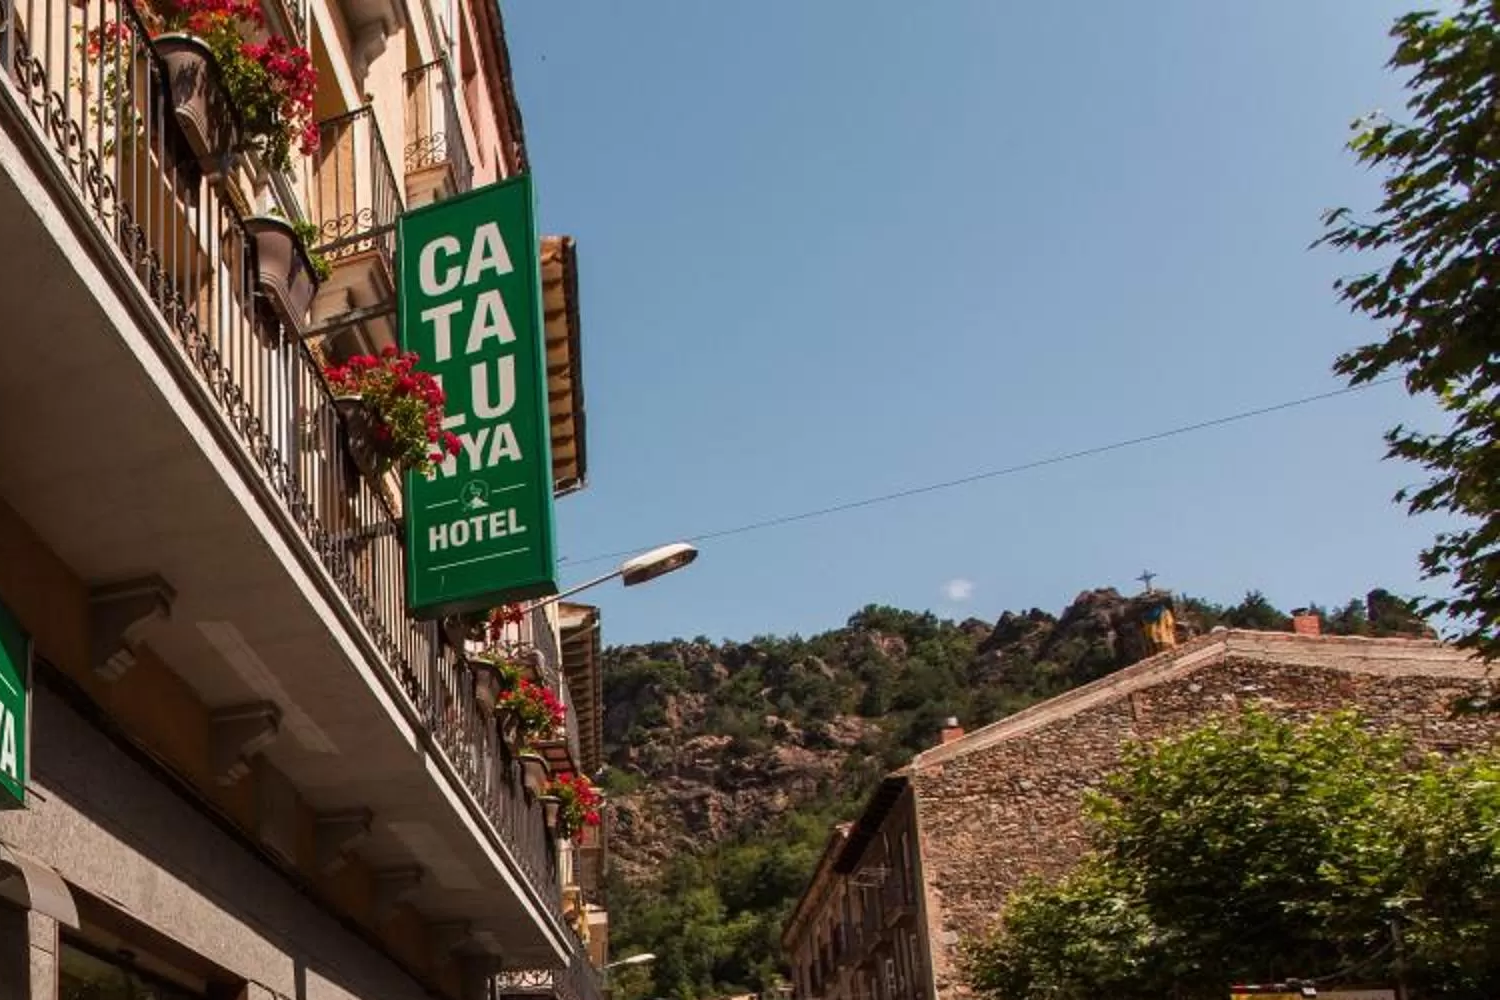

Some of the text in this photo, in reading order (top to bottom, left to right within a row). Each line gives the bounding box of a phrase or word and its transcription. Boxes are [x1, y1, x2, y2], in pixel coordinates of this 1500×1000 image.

[418, 221, 514, 297] CA
[421, 288, 517, 363] TA
[428, 508, 527, 552] HOTEL
